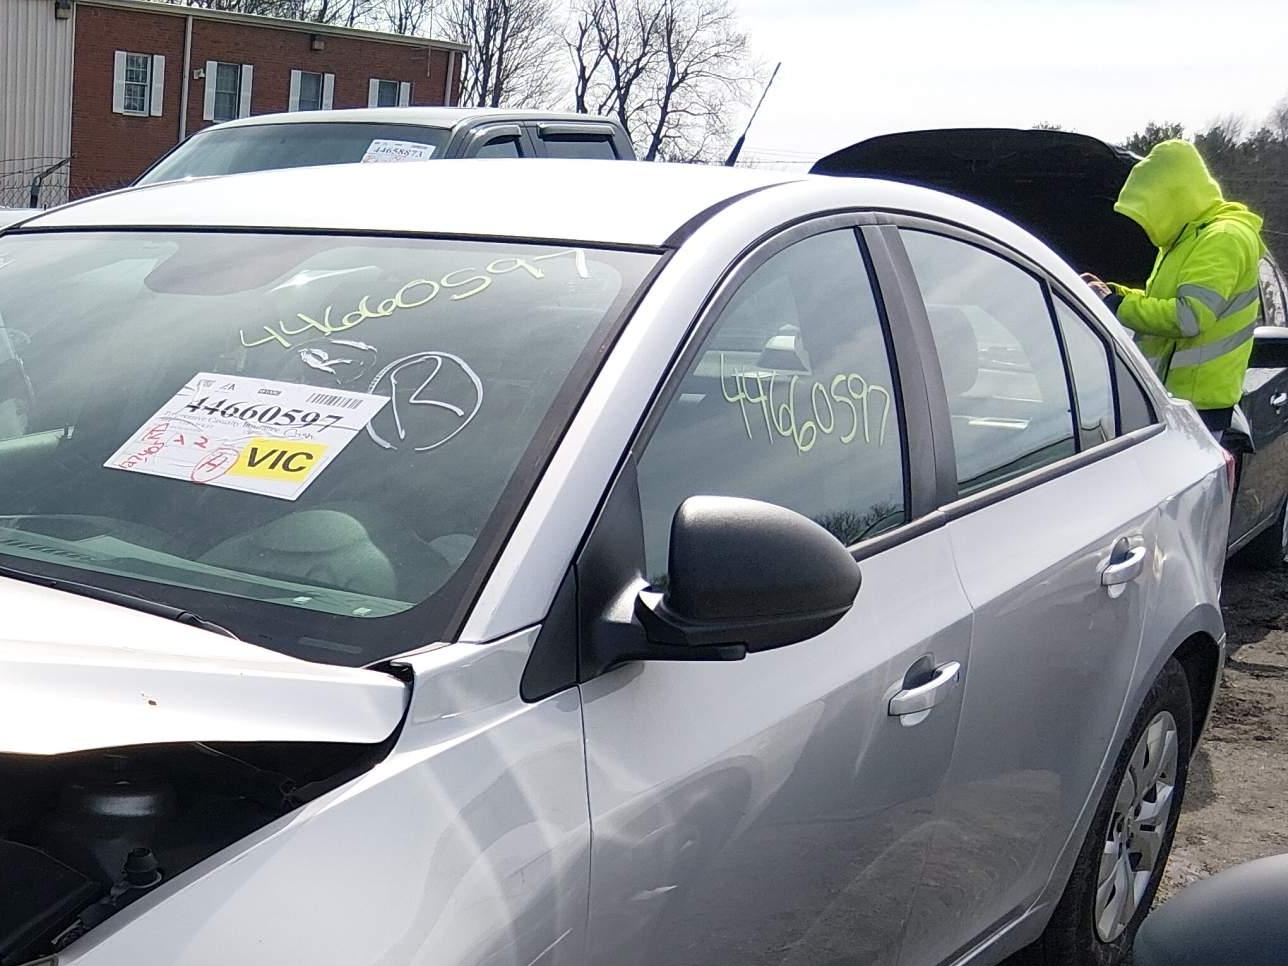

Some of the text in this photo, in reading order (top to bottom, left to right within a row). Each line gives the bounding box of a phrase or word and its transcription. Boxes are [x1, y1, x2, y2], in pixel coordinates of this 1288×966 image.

[239, 248, 592, 348] 44660597
[184, 396, 344, 433] 44660597
[720, 352, 891, 457] 44660597
[246, 447, 314, 473] VIC
